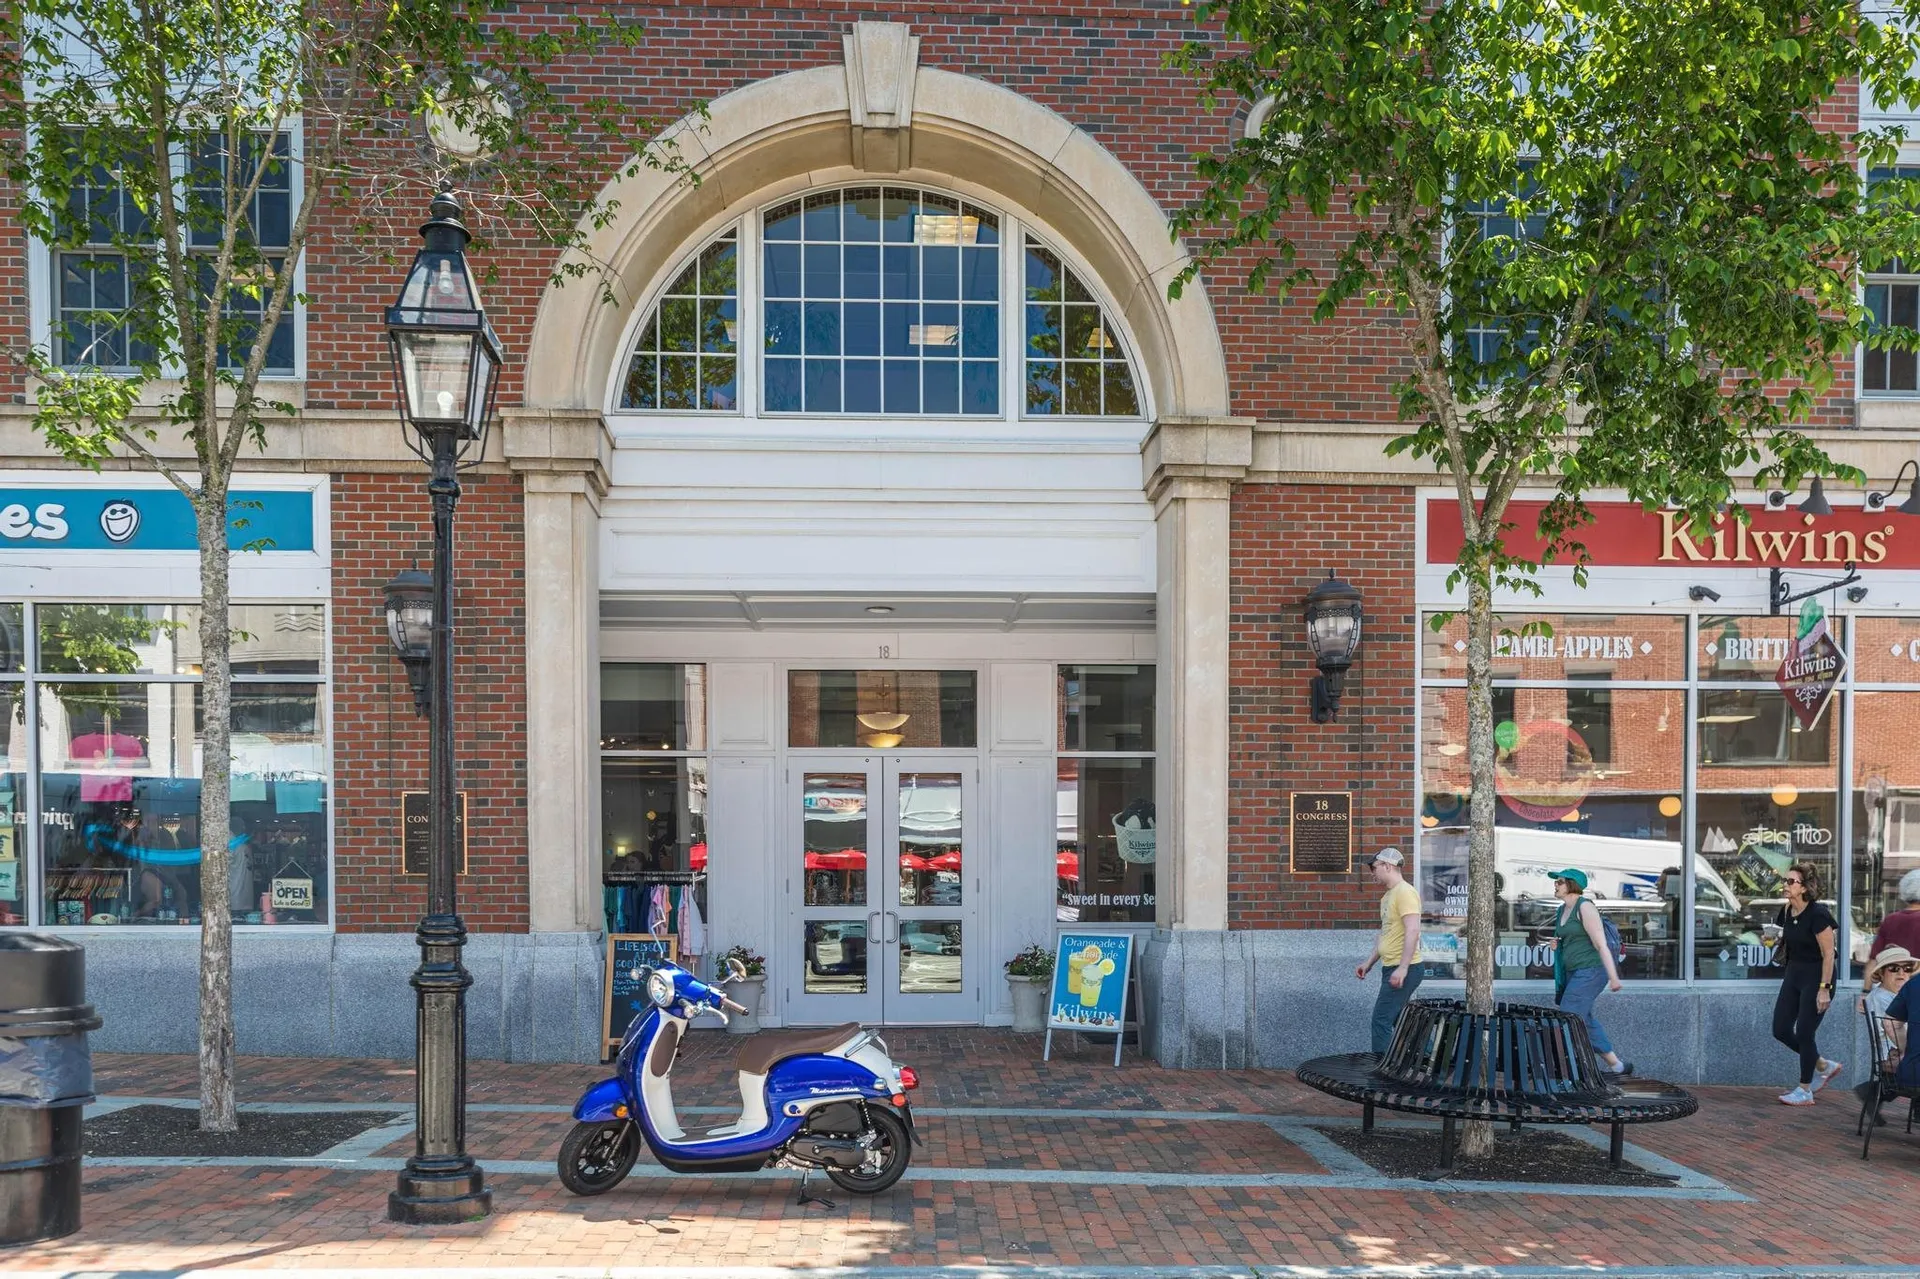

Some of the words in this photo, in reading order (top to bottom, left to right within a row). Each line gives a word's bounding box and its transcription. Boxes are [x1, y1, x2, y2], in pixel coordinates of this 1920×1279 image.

[879, 645, 890, 659] 18
[1563, 636, 1633, 659] APPLES
[1784, 655, 1836, 680] Kilwins
[1315, 800, 1328, 811] 18
[1129, 840, 1156, 848] Kilwin
[277, 887, 307, 899] OPEN
[1100, 893, 1110, 906] in
[1113, 895, 1141, 907] every
[1065, 937, 1116, 950] Orangeade
[1495, 945, 1555, 967] CHOCO
[1055, 1002, 1117, 1021] Kilwins
